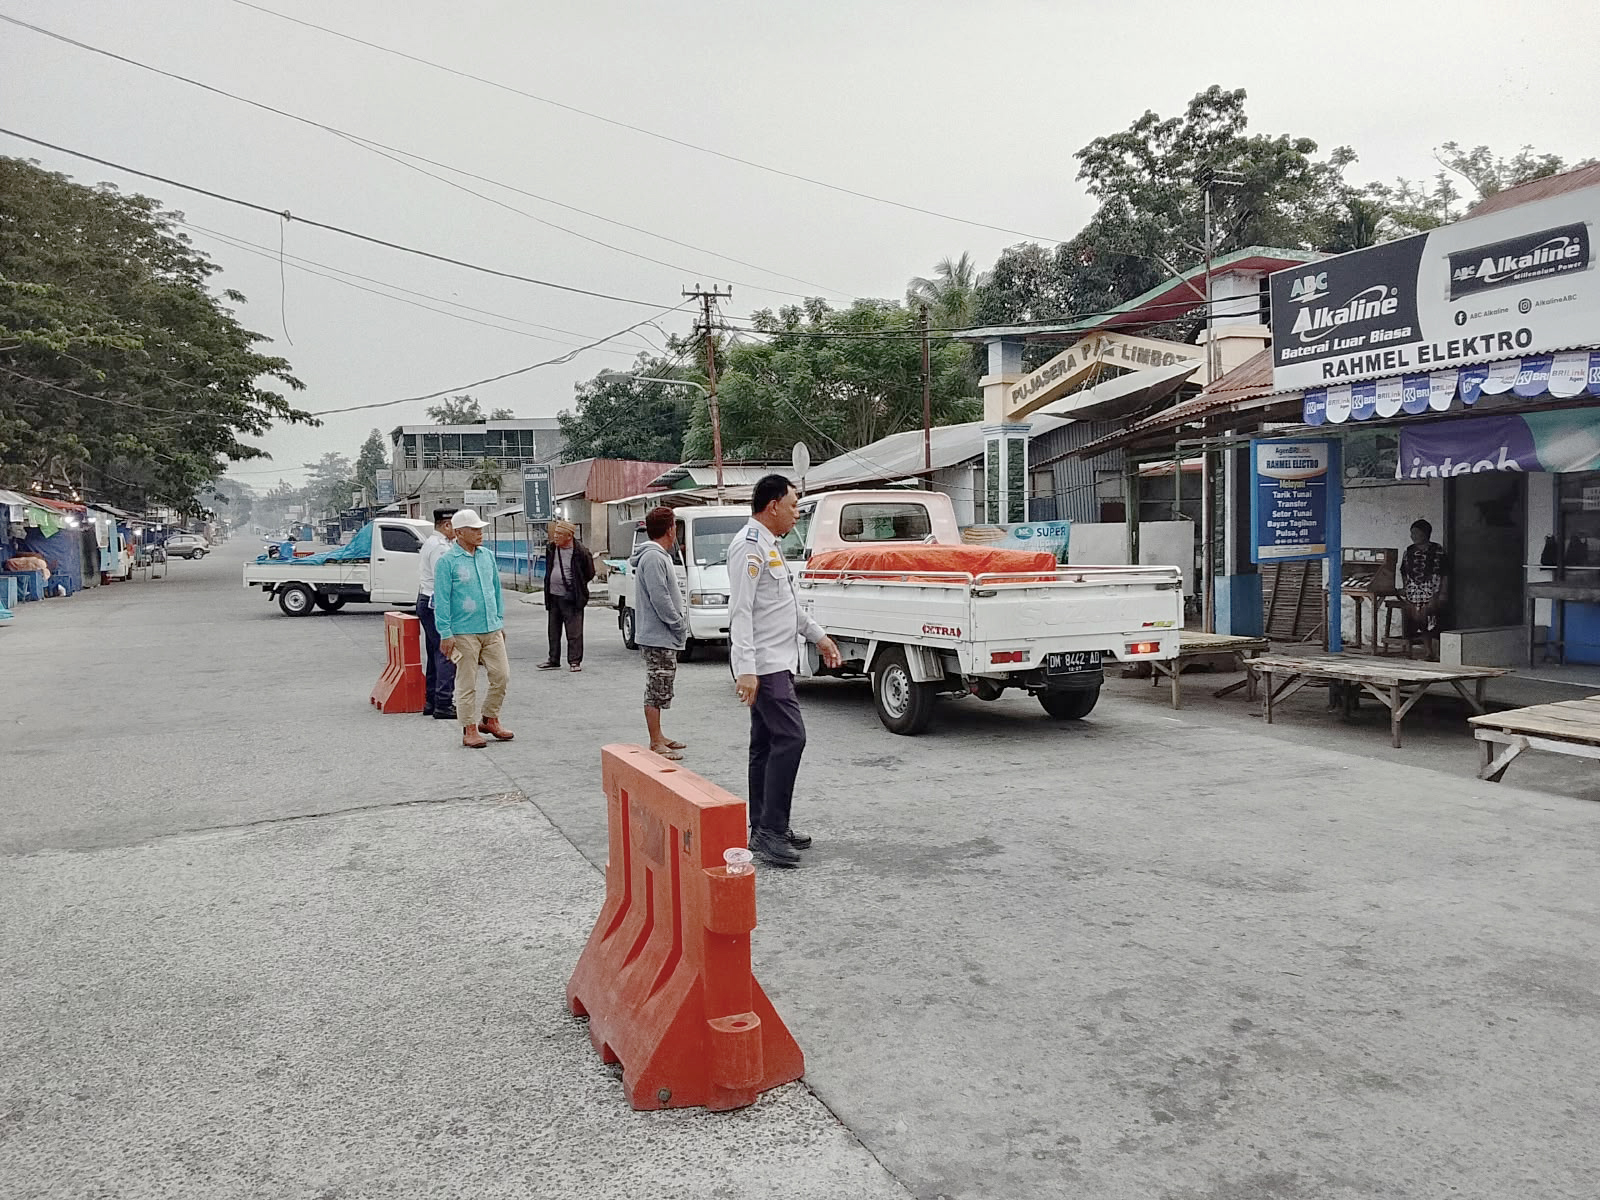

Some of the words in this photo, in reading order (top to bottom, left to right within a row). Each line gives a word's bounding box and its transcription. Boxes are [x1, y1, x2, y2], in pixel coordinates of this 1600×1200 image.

[1453, 265, 1475, 278] ABC
[1475, 243, 1580, 278] Alkaline
[1513, 266, 1555, 280] Millennium
[1558, 261, 1582, 271] Power
[1290, 272, 1328, 298] ABC
[1535, 294, 1577, 307] AlkalineABC
[1291, 297, 1398, 335] Alkaline
[1484, 307, 1509, 317] Alkaline
[1281, 340, 1330, 360] Baterai
[1333, 335, 1366, 351] Luar
[1369, 326, 1412, 344] Biasa
[1322, 349, 1410, 379] RAHMEL
[1417, 327, 1533, 365] ELEKTRO
[1011, 353, 1077, 405] PUJASERA
[1551, 369, 1586, 377] BRILink
[1266, 460, 1291, 469] RAHMEL
[1292, 459, 1319, 468] ELECTRO
[1272, 491, 1292, 499] Tarik
[1293, 490, 1312, 498] Tunai
[1277, 500, 1308, 508] Transfer
[1272, 510, 1292, 518] Setor
[1293, 509, 1313, 517] Tunai
[1267, 520, 1289, 529] Bayar
[1290, 519, 1317, 528] Tagihan
[1036, 526, 1066, 537] SUPER
[1049, 655, 1061, 668] DM
[1065, 653, 1085, 666] 8442
[1090, 651, 1100, 664] AD
